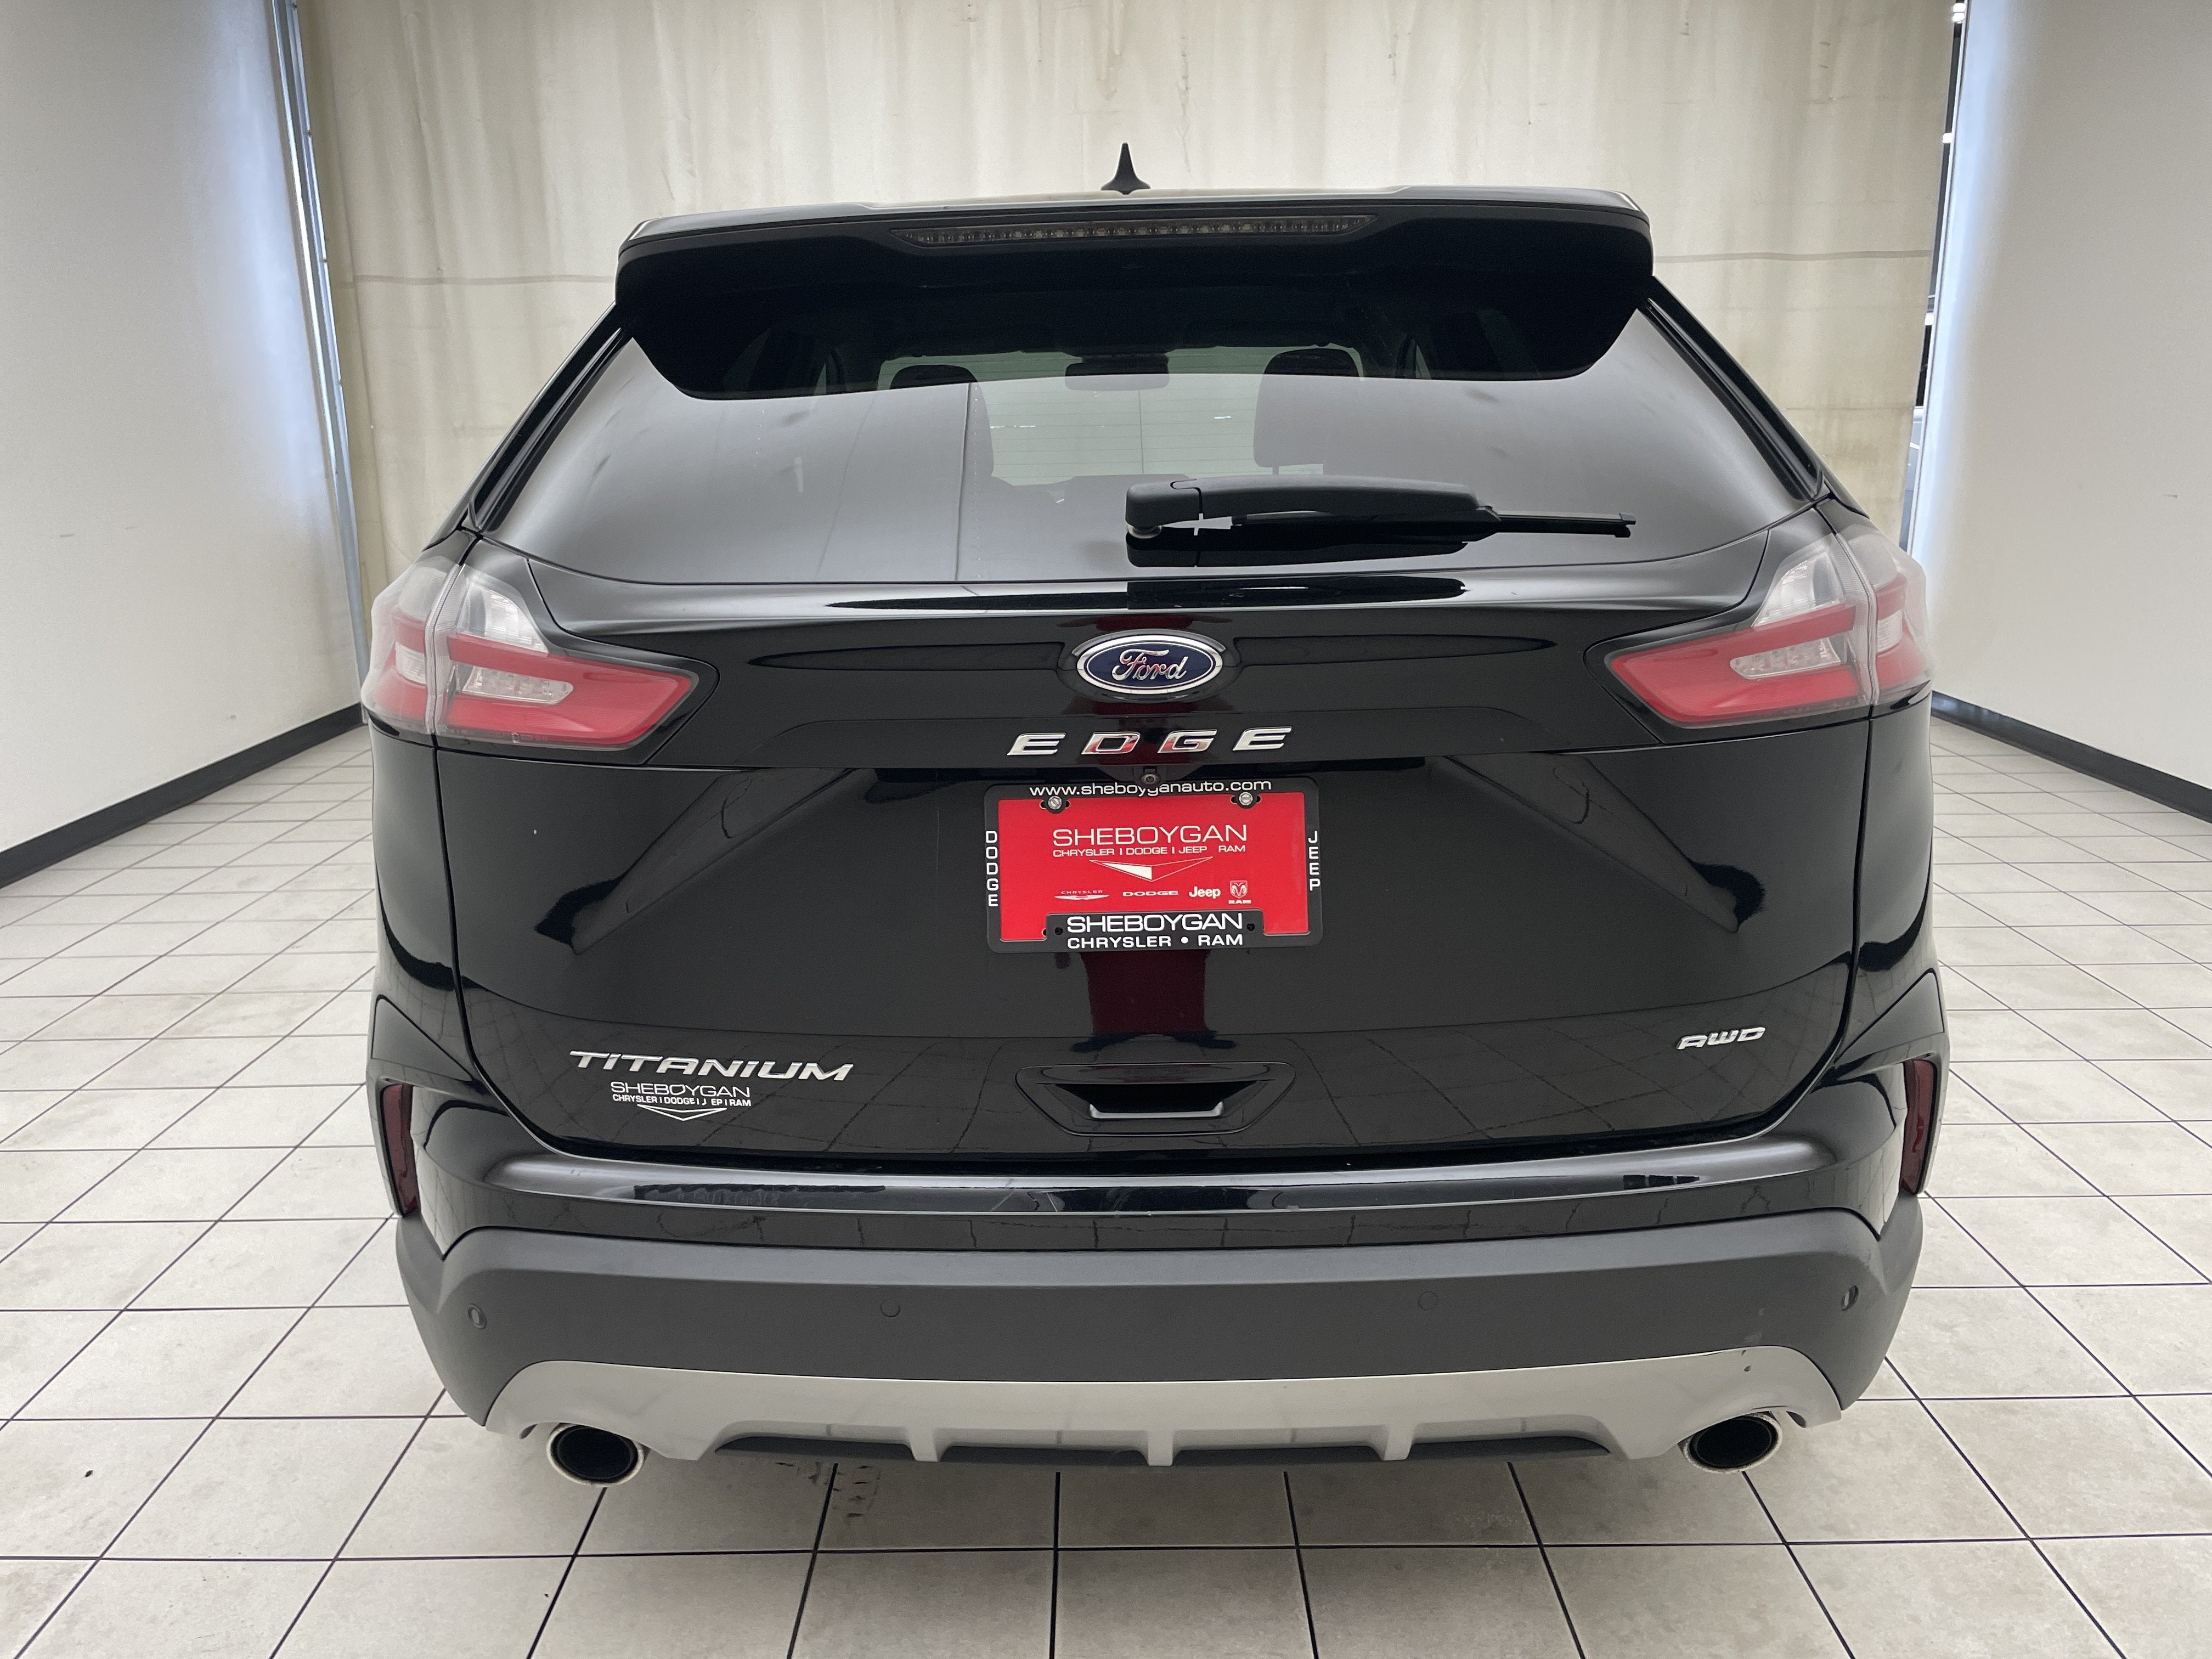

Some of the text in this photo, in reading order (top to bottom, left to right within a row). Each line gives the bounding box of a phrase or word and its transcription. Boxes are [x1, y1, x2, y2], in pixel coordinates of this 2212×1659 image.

[1111, 648, 1189, 681] Ford
[1006, 726, 1293, 756] EDGE
[1029, 781, 1272, 797] www.sheboyganauto.com
[1052, 824, 1247, 847] SHEBOYGAN
[1052, 844, 1246, 857] CHRYSLER DODGE JEEP RAM
[1307, 830, 1321, 891] JEEP
[985, 830, 1000, 907] DODGE
[1188, 885, 1221, 899] Jeep
[1066, 912, 1243, 933] SHEBOYGAN
[1066, 934, 1243, 949] CHRYSLER RAM
[1675, 1026, 1766, 1050] AWD
[569, 1050, 854, 1081] TITANIUM
[610, 1081, 751, 1098] SHEBOYGAN
[612, 1093, 658, 1104] CHRYSLER
[664, 1097, 696, 1105] DODGE
[729, 1098, 752, 1107] RAM
